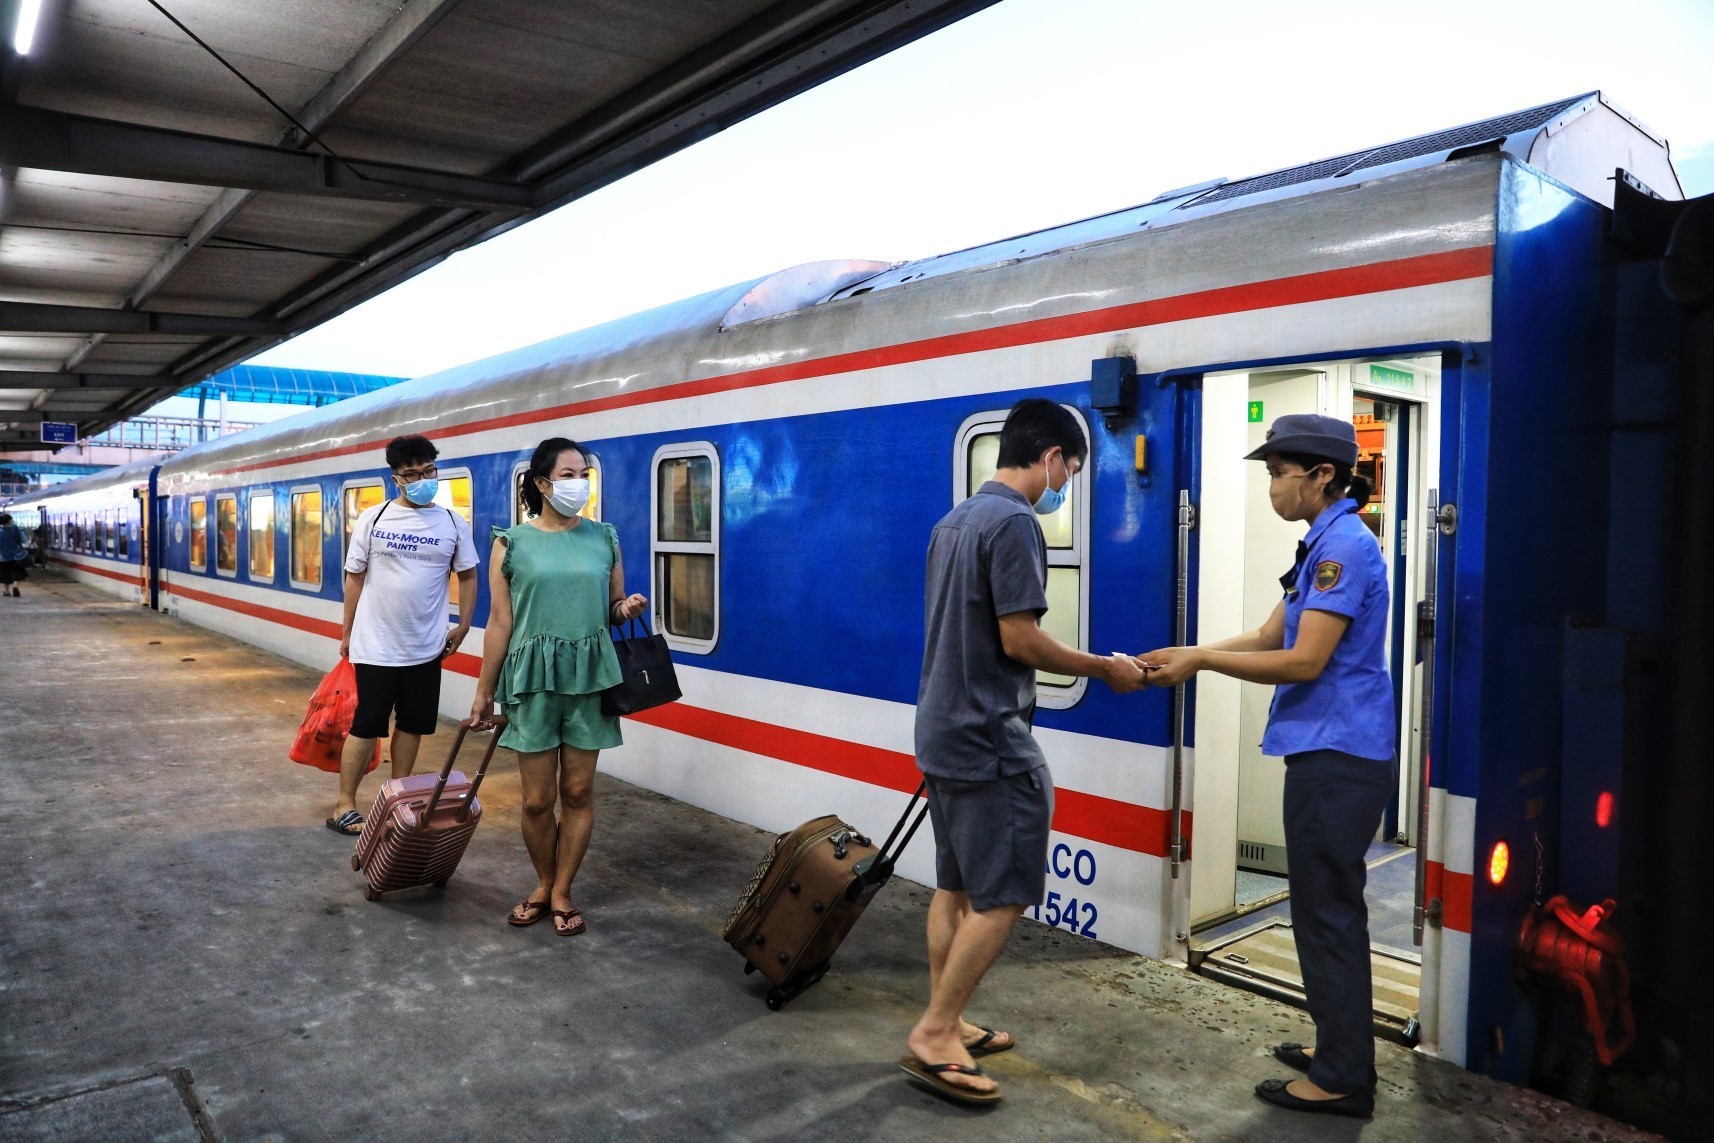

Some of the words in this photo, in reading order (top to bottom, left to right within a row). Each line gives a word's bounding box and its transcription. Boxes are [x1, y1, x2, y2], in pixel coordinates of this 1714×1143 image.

[370, 529, 440, 546] KELLY-MOORE
[386, 542, 418, 552] PAINTS
[1045, 843, 1097, 885] CO
